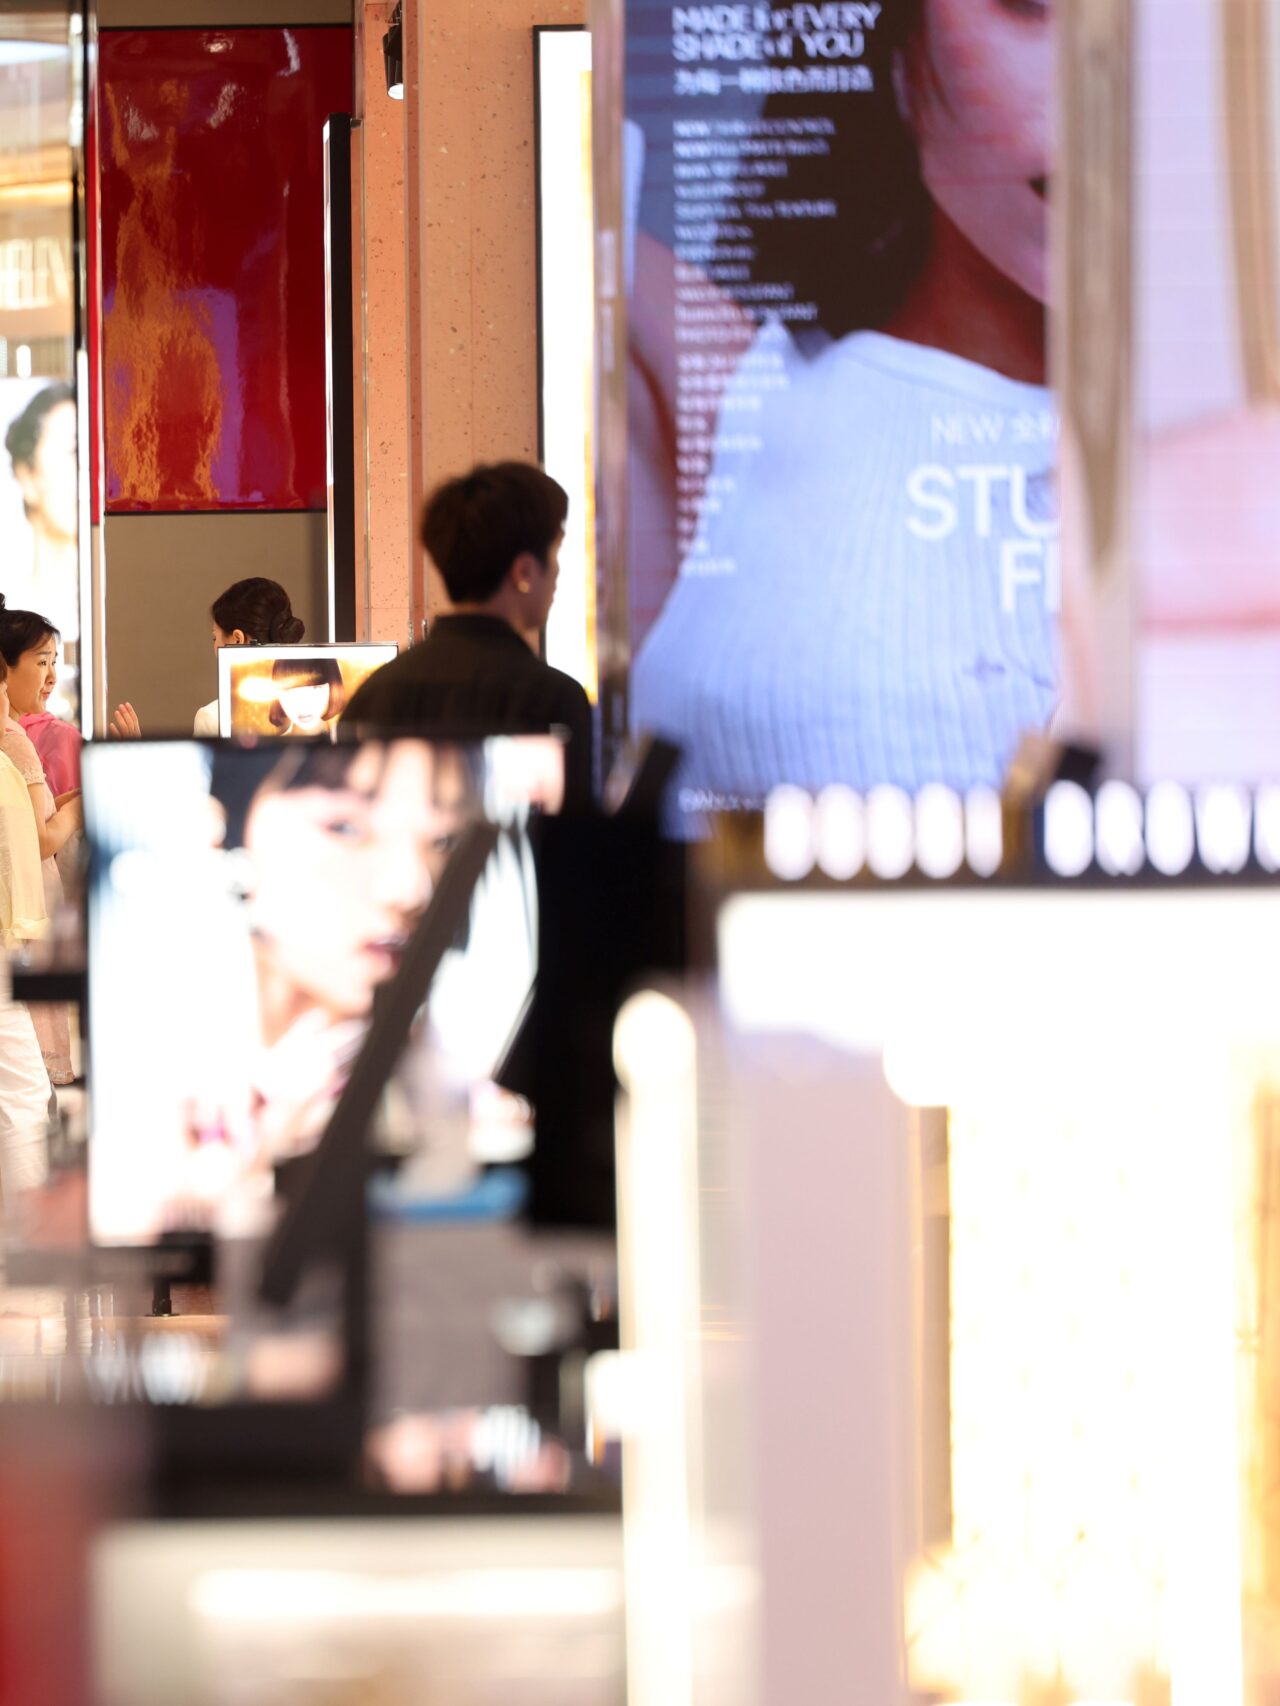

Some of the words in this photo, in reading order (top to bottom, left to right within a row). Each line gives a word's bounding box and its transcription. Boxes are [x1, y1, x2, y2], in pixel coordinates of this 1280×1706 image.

[672, 5, 751, 32] MADE
[792, 2, 882, 31] EVERY
[672, 32, 764, 62] SHADE
[800, 31, 865, 59] YOU
[931, 412, 1004, 444] NEW
[906, 465, 1061, 541] STU
